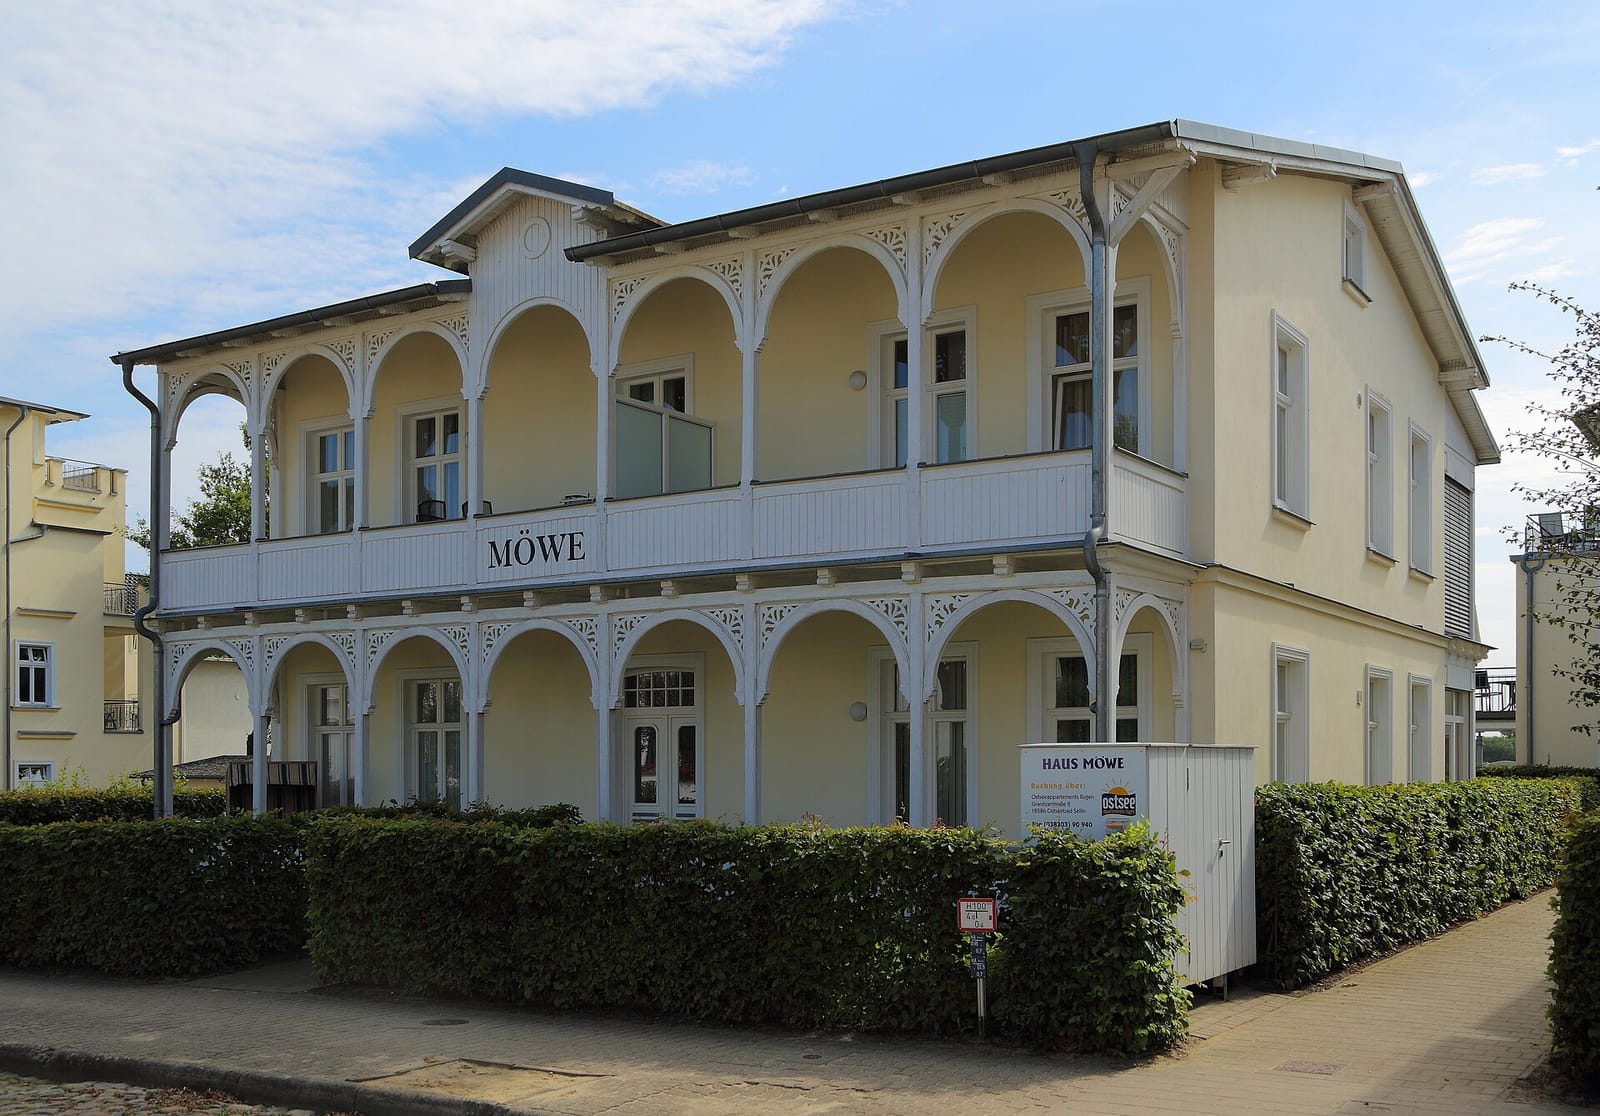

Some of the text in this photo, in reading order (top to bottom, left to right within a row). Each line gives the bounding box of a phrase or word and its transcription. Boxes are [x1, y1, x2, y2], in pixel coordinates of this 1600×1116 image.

[487, 529, 586, 569] MÖWE
[1042, 755, 1125, 770] HAUS MÖWE
[1030, 782, 1087, 791] Buchung über:
[1102, 794, 1136, 810] ostsee
